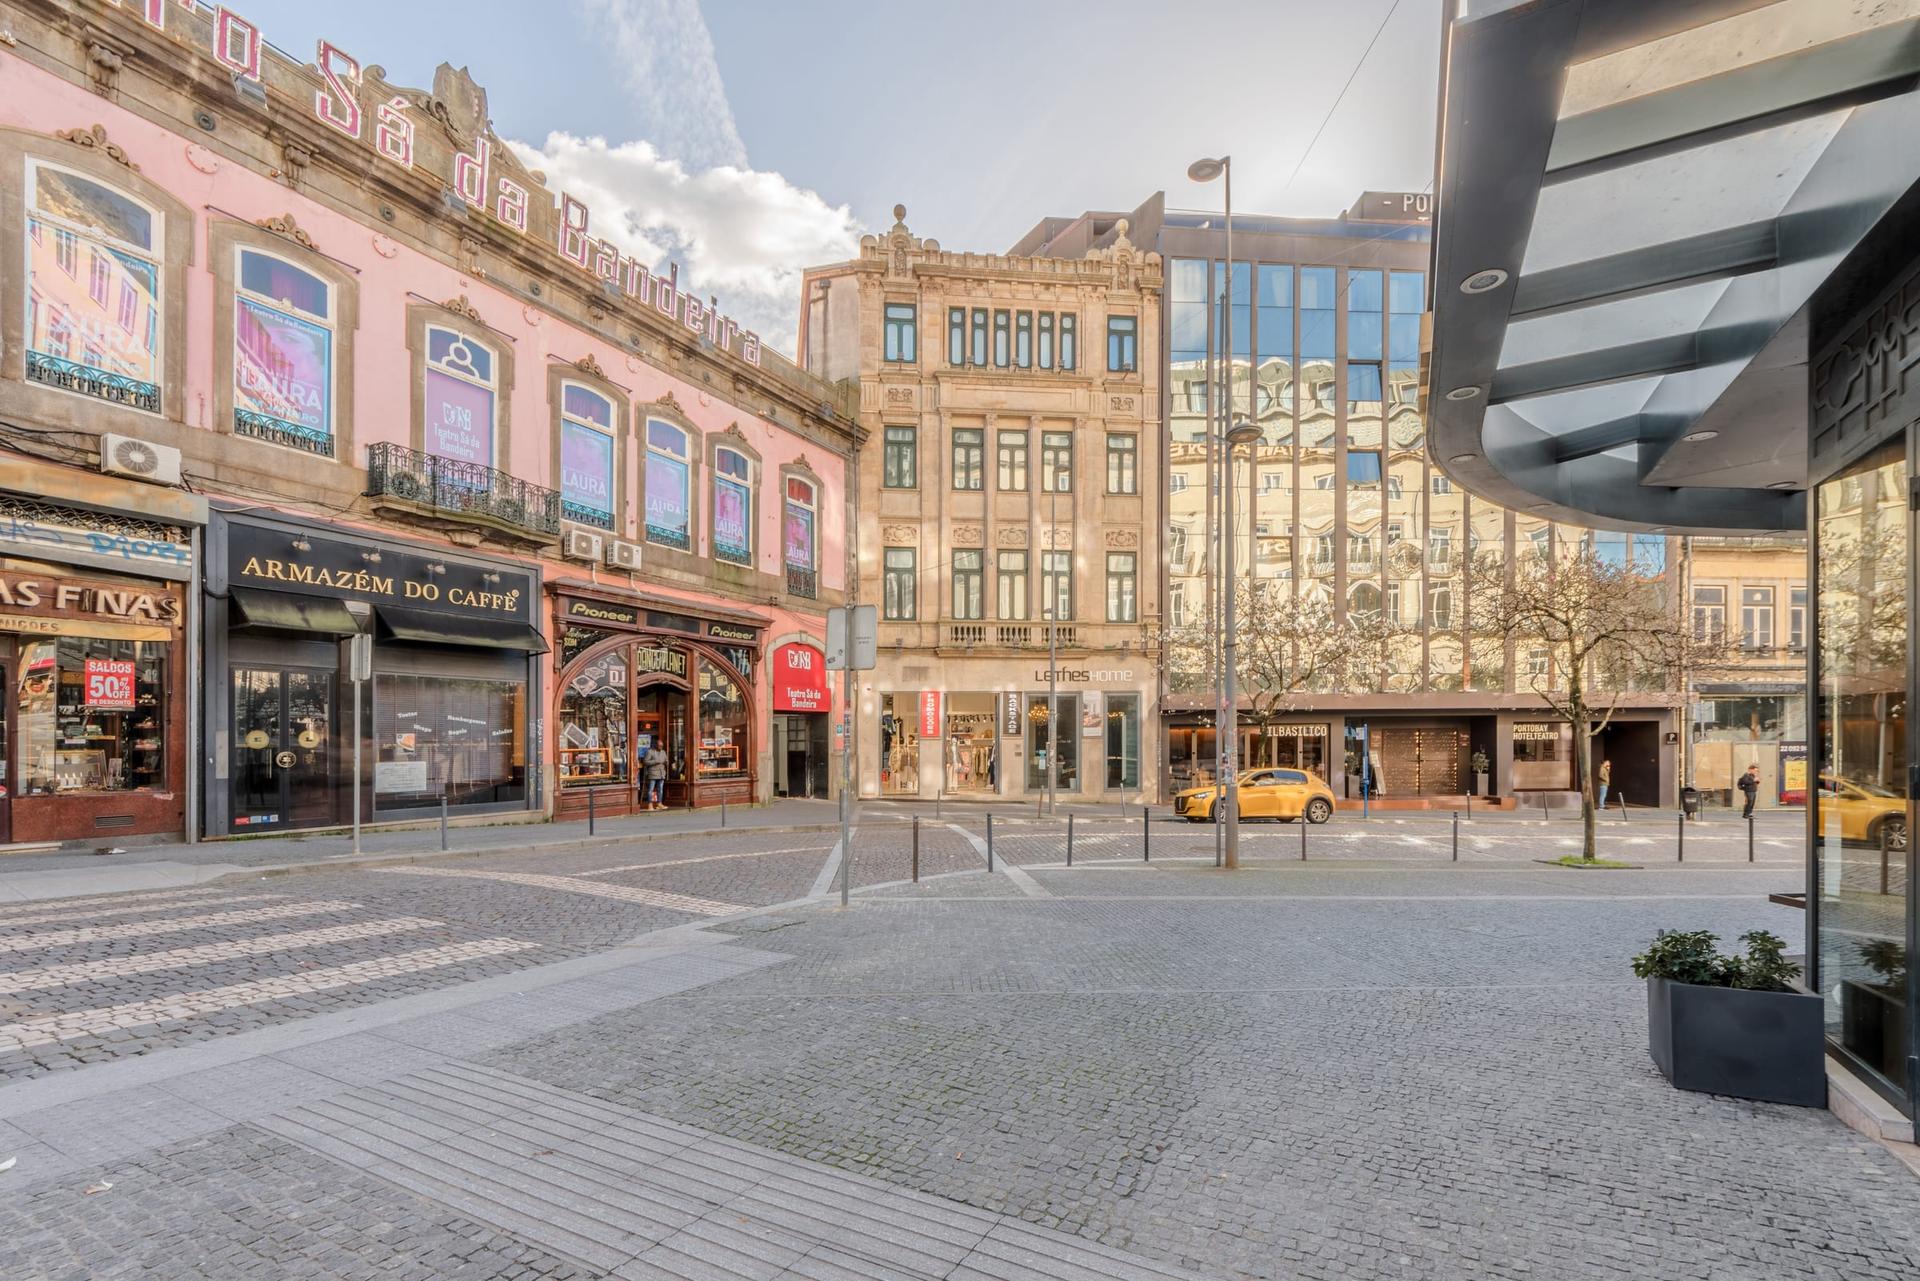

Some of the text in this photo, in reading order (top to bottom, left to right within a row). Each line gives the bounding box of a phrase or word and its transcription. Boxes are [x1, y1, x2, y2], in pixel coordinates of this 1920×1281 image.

[315, 39, 415, 169] Sá
[455, 129, 528, 234] da
[558, 191, 761, 367] Bandeira
[563, 469, 607, 497] LAURA
[241, 556, 394, 595] ARMAZÉM
[404, 580, 440, 601] DO
[572, 603, 633, 622] Pioneer
[710, 625, 754, 641] Pioneer
[89, 661, 131, 673] SALDOS
[113, 691, 130, 699] OFF
[787, 687, 806, 698] Teatro
[814, 690, 821, 699] da
[791, 698, 817, 708] Bandeira
[1513, 724, 1548, 732] PORTOBAY
[1669, 733, 1676, 741] P
